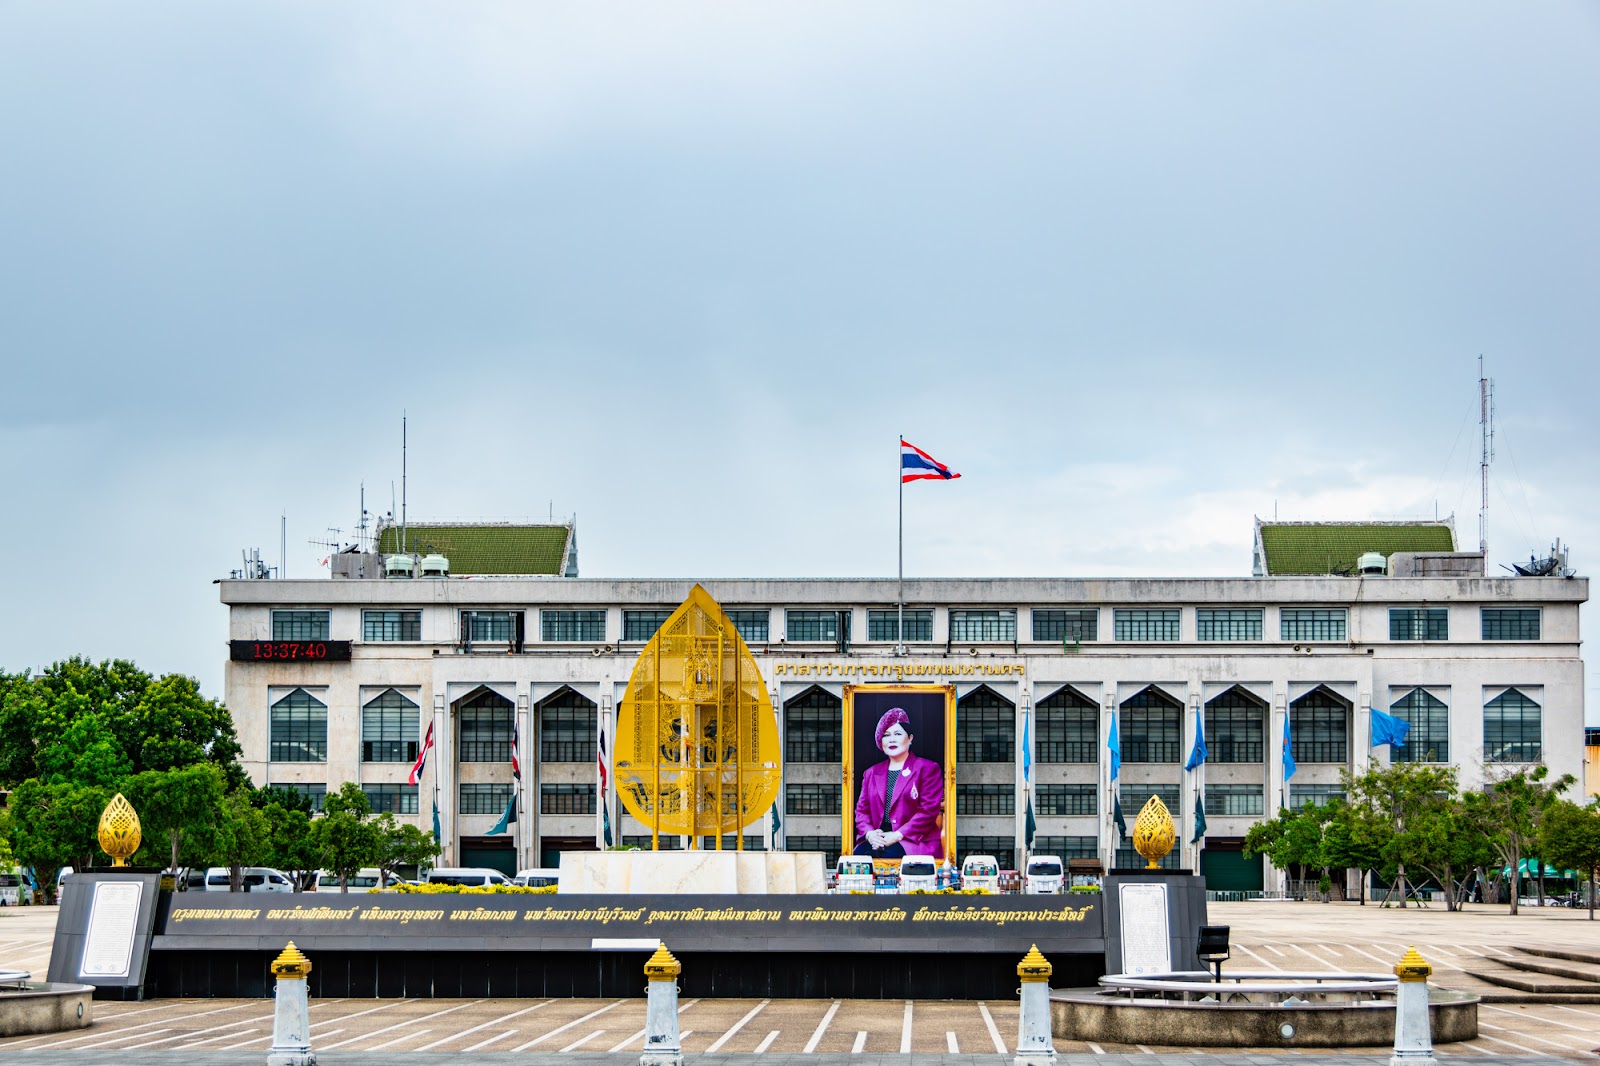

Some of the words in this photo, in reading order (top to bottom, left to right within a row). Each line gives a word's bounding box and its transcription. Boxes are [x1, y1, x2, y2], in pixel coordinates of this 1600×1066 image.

[253, 643, 327, 659] 13:37:40
[774, 663, 1025, 680] ศาลาว่าการกรุงเทพมหานคร
[171, 908, 261, 923] กรุงเทพมหานคร
[450, 907, 517, 921] มหาดิลกภพ
